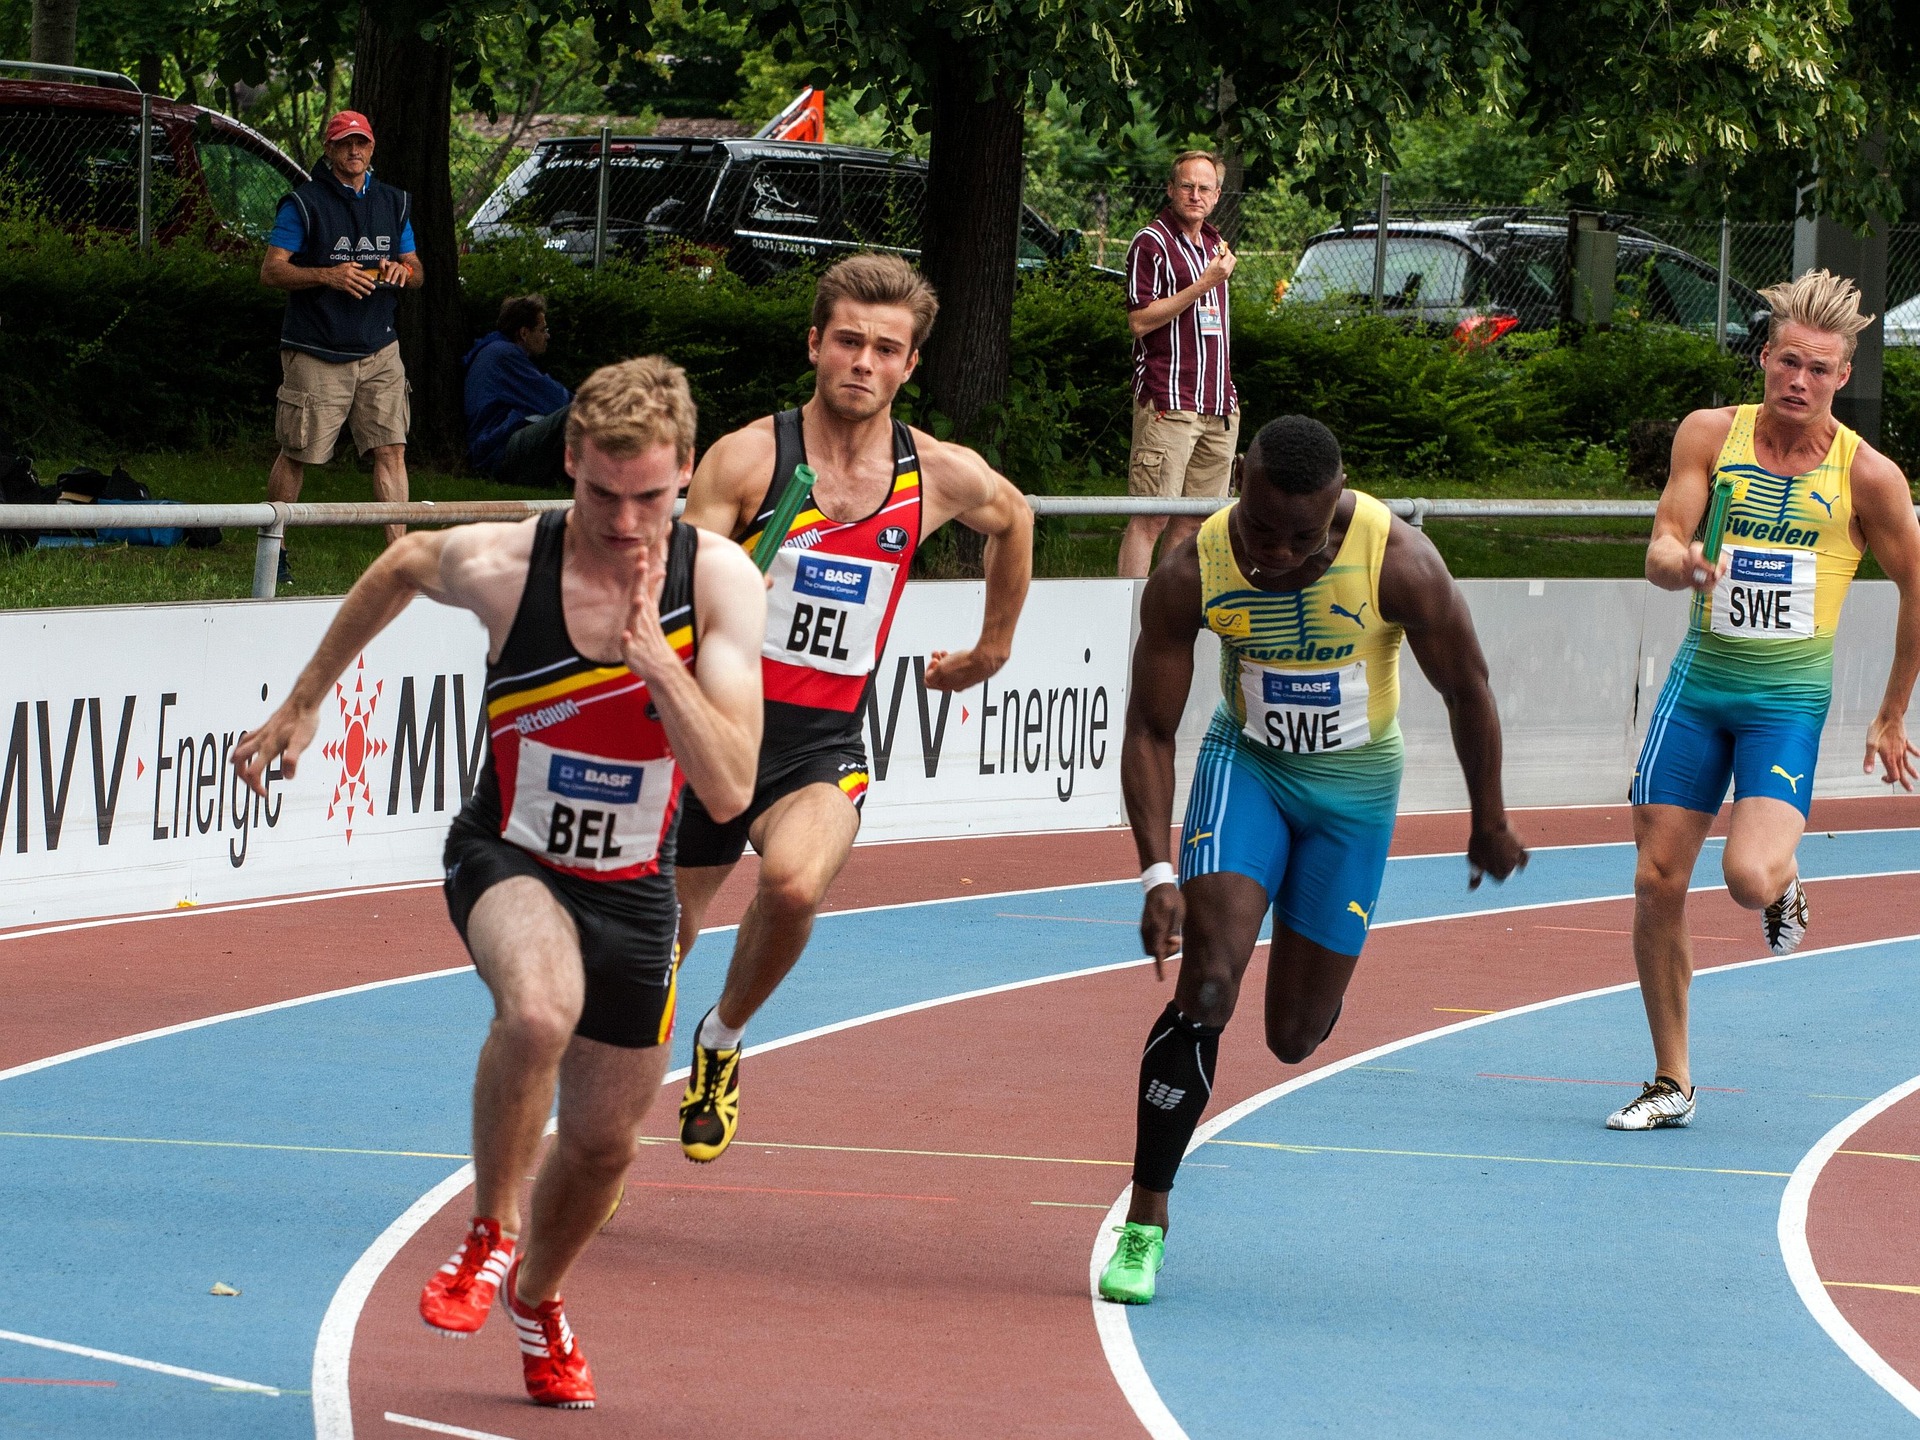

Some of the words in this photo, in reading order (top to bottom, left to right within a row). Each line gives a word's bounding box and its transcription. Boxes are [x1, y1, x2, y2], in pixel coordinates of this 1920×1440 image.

[741, 147, 822, 160] www.gauch.de
[333, 235, 391, 252] AAC
[824, 569, 862, 586] BASF
[1754, 559, 1786, 570] BASF
[1729, 586, 1792, 630] SWE
[786, 602, 849, 661] BEL
[1291, 682, 1331, 693] BASF
[515, 699, 580, 735] BELGIUM
[979, 648, 1108, 802] Energie
[1265, 710, 1342, 753] SWE
[584, 768, 633, 788] BASF
[547, 802, 622, 859] BEL
